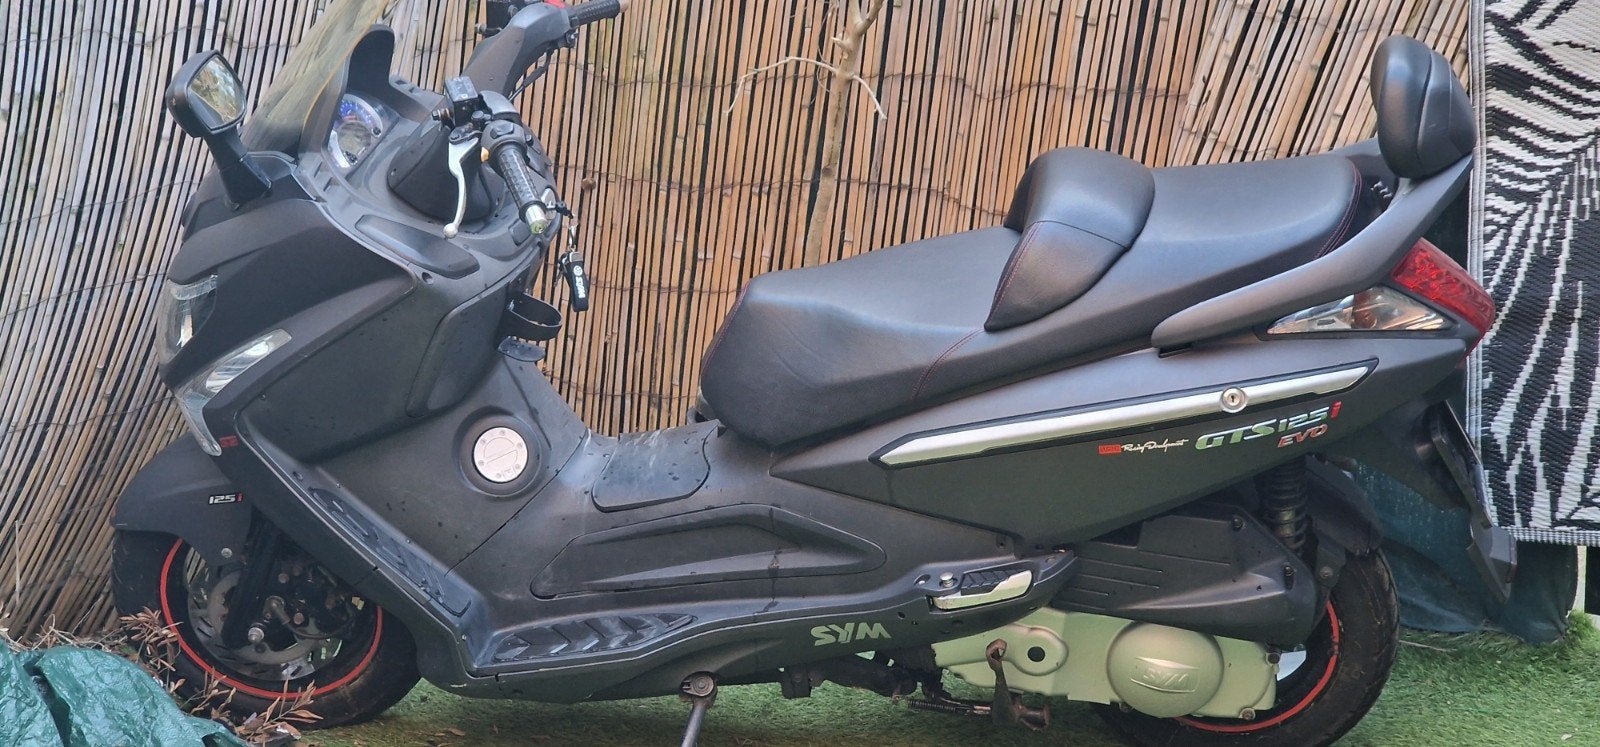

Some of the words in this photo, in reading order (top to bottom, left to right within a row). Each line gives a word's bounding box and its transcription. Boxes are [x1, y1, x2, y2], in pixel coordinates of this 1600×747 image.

[1278, 424, 1328, 448] EVO
[810, 622, 892, 647] SYM
[1143, 667, 1193, 687] SYM
